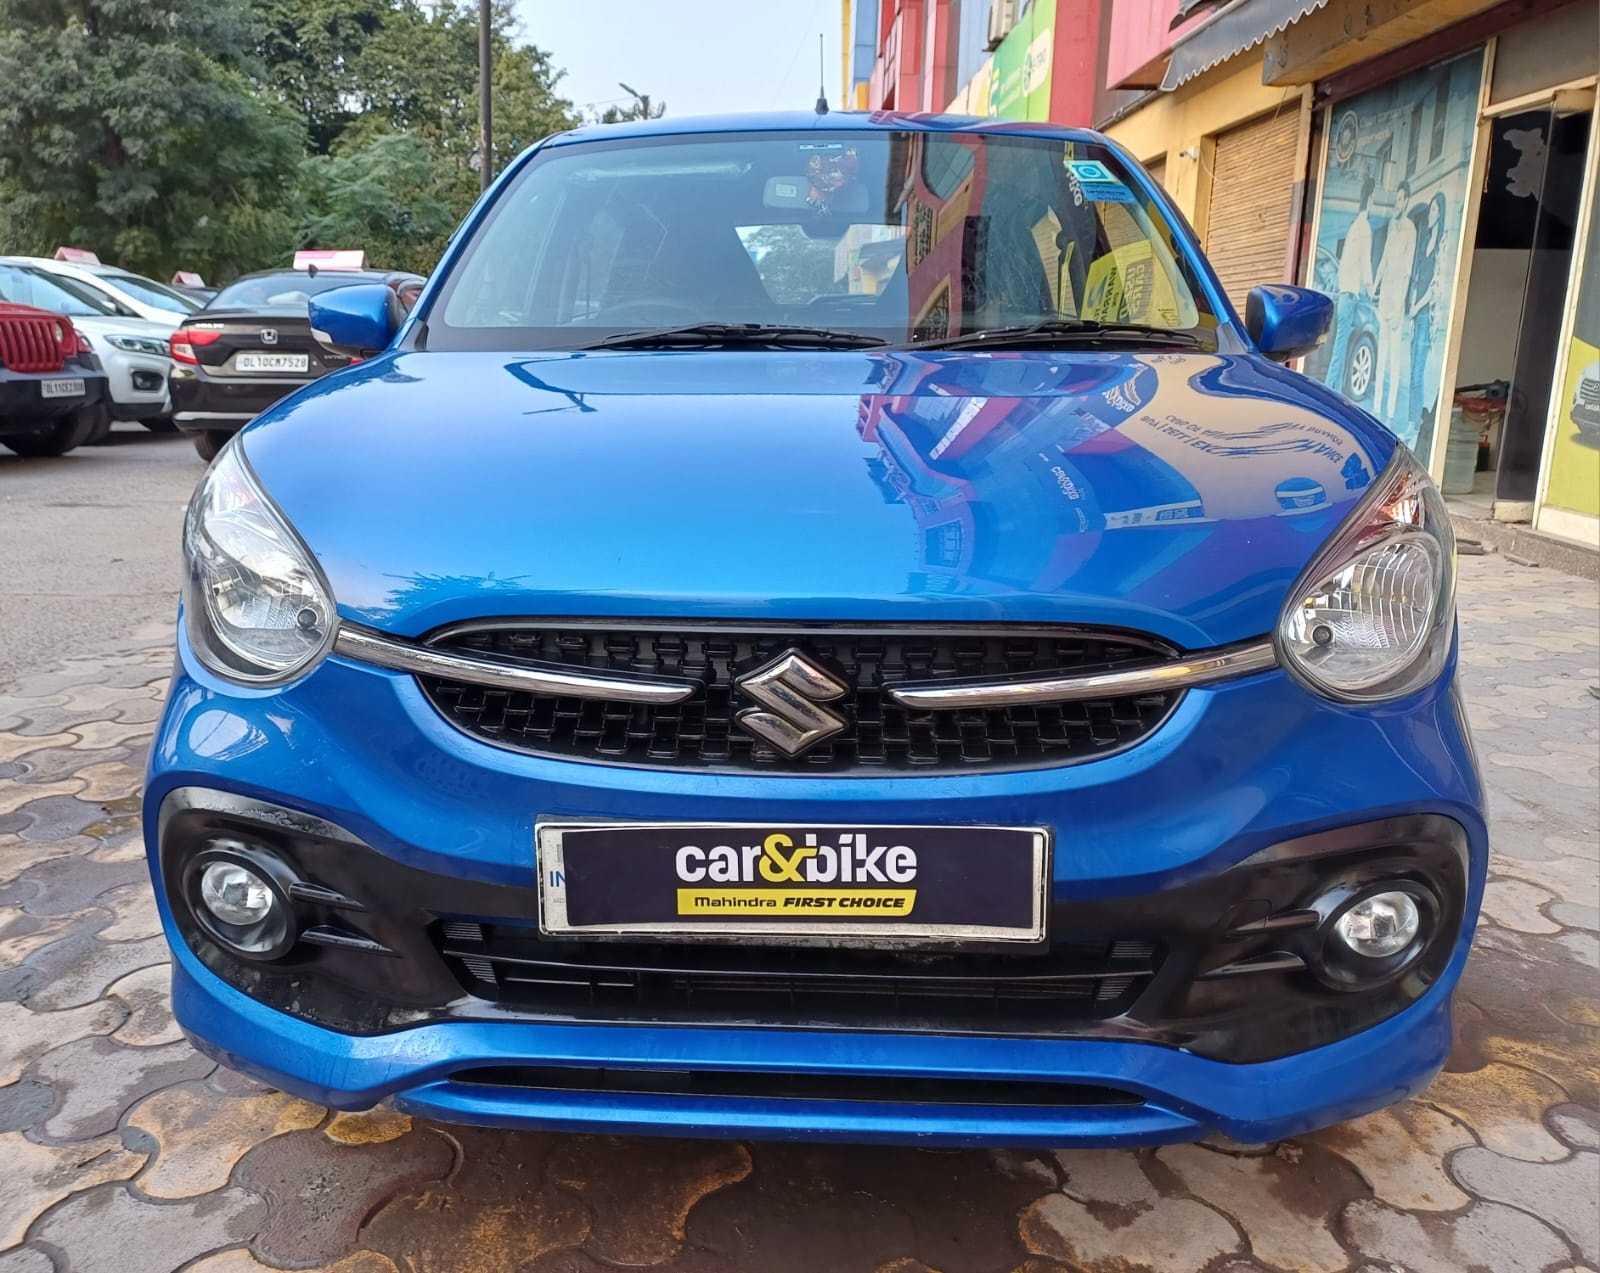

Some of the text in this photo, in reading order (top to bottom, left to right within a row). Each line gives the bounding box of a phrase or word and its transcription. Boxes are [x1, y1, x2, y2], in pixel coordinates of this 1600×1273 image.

[675, 833, 918, 883] car&bike
[694, 896, 905, 909] Mahindra FIRST CHOICE
